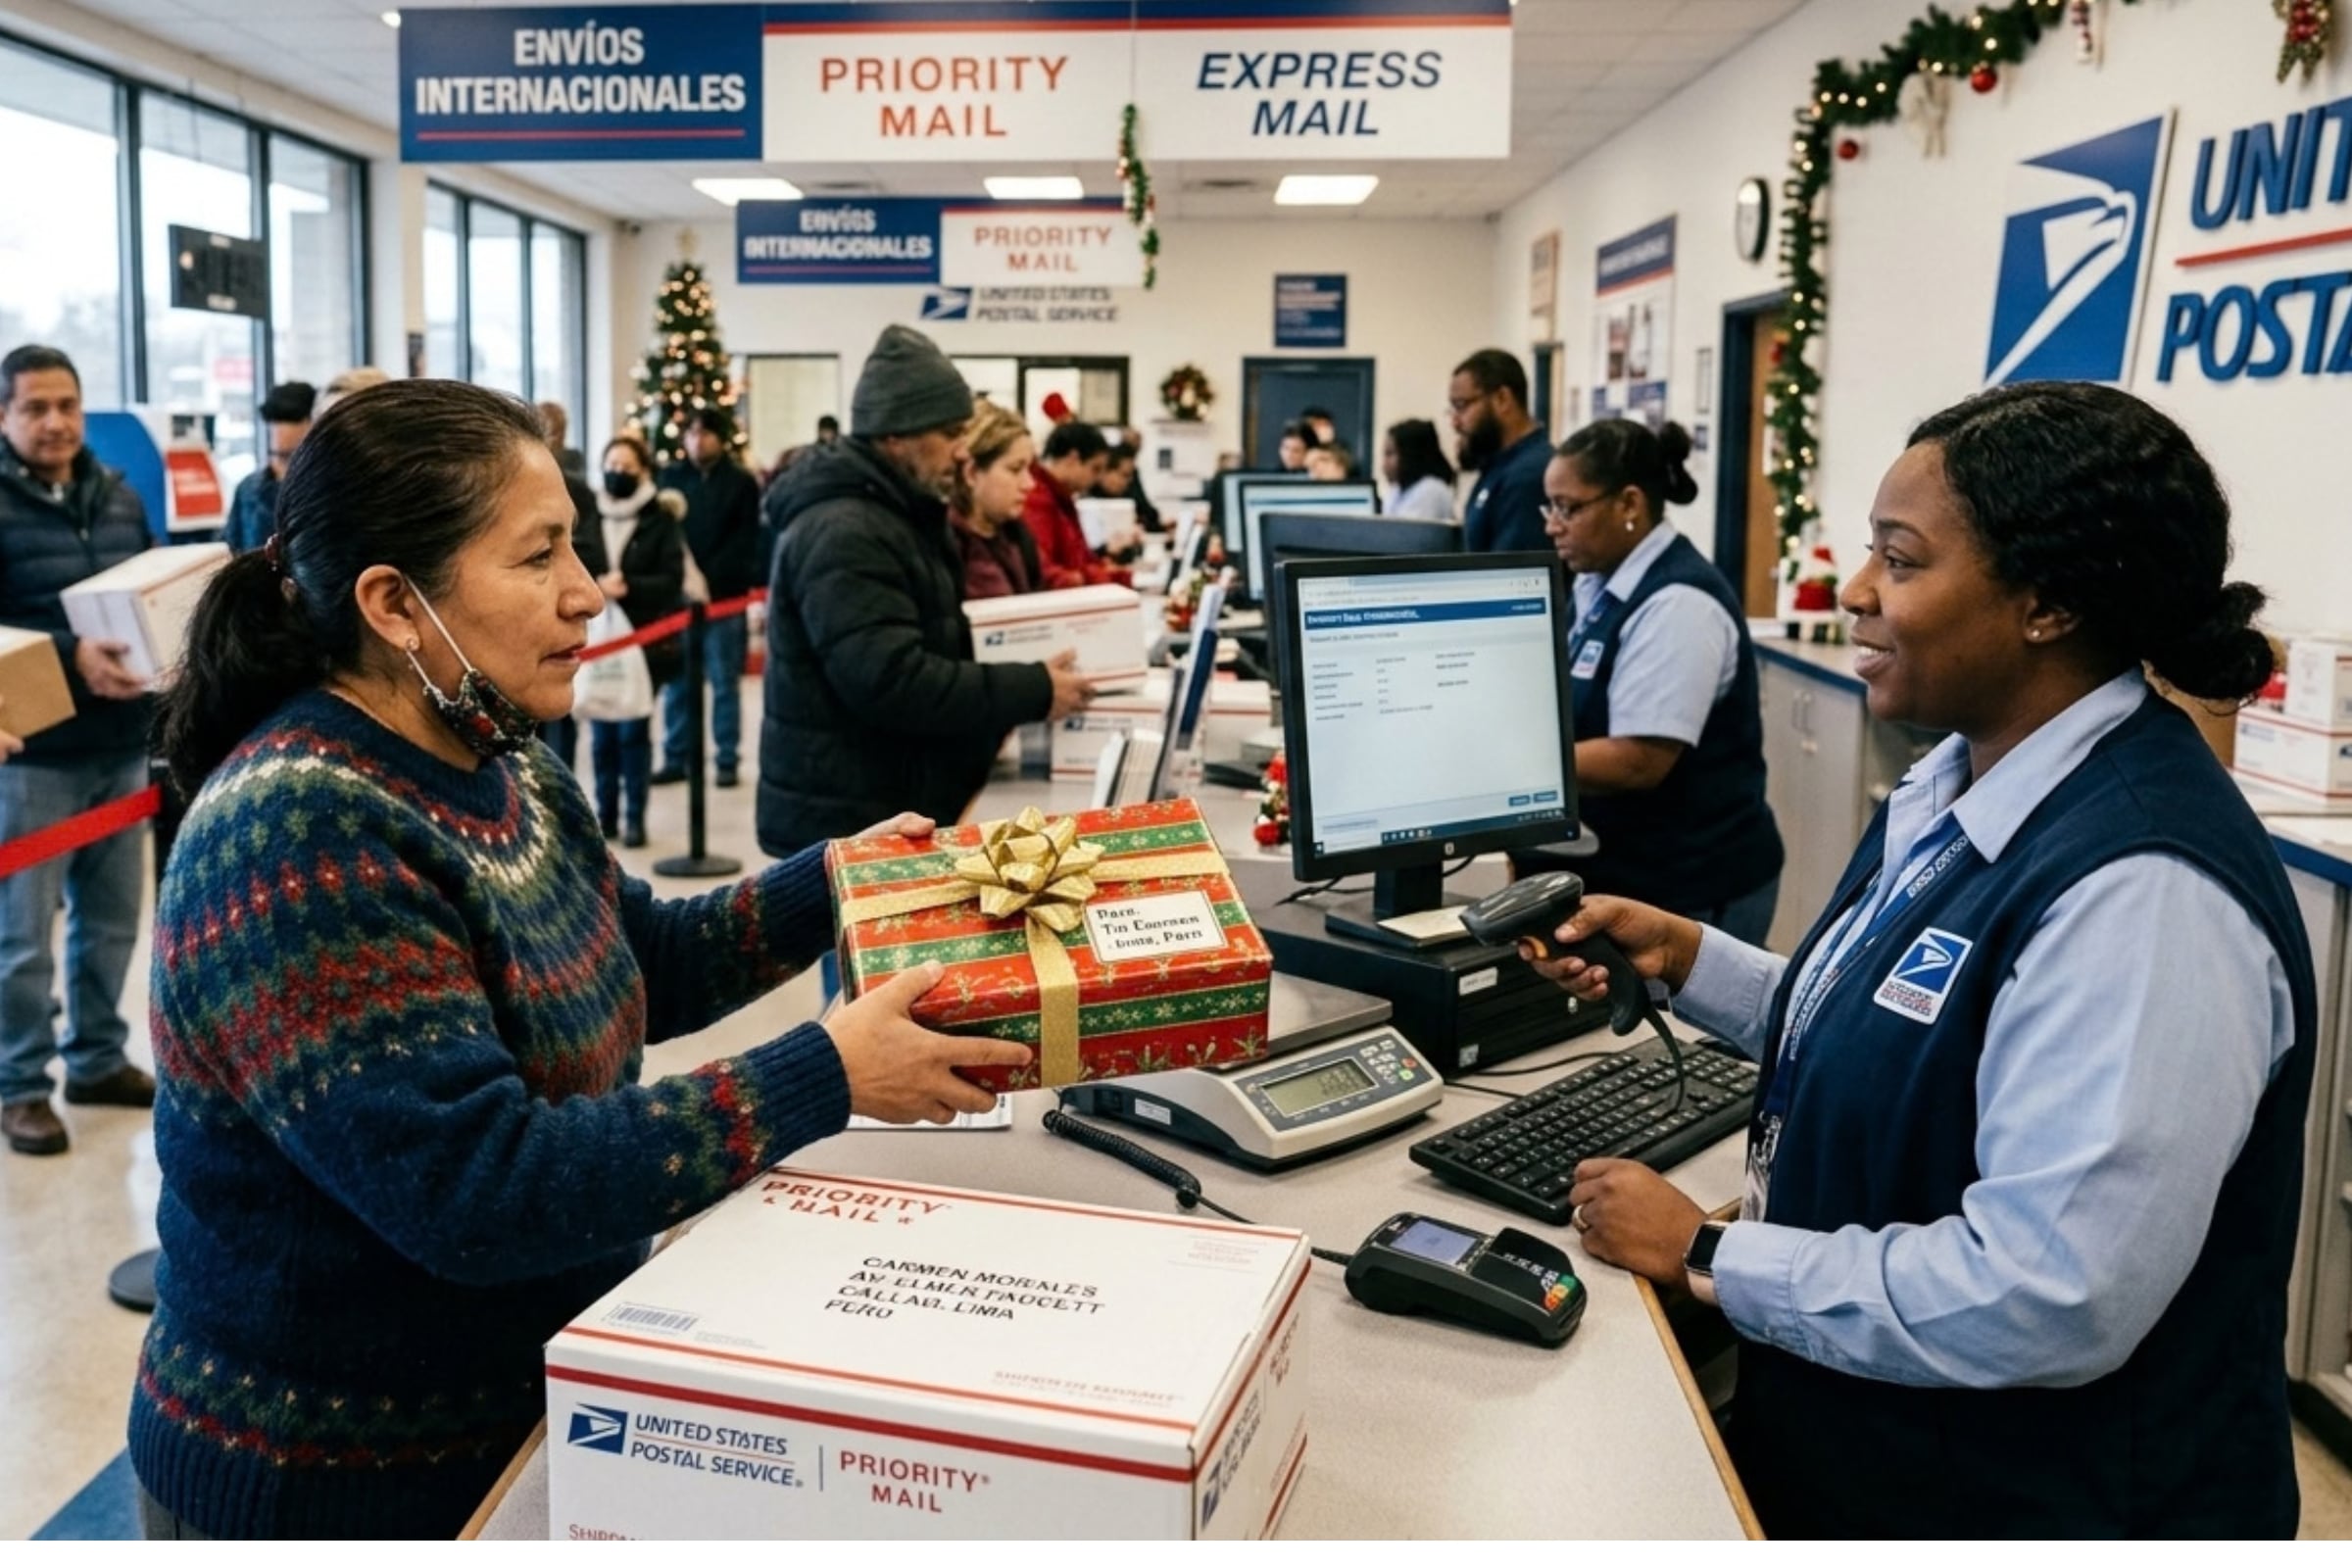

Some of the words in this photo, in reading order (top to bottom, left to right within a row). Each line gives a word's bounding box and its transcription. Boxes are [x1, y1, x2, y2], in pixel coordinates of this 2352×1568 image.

[514, 20, 645, 66] ENVÍOS
[820, 56, 1069, 93] PRIORITY
[1197, 52, 1443, 89] EXPRESS
[416, 74, 746, 115] INTERNACIONALES
[880, 105, 1007, 137] MAIL
[1252, 100, 1380, 136] MAIL
[973, 226, 1112, 248] PRIORITY
[1007, 253, 1079, 271] MAIL
[761, 1181, 946, 1214] PRIORITY
[635, 1413, 712, 1442] UNITED
[715, 1427, 788, 1455] STATES
[630, 1441, 707, 1471] POSTAL
[871, 1484, 943, 1514] MAIL
